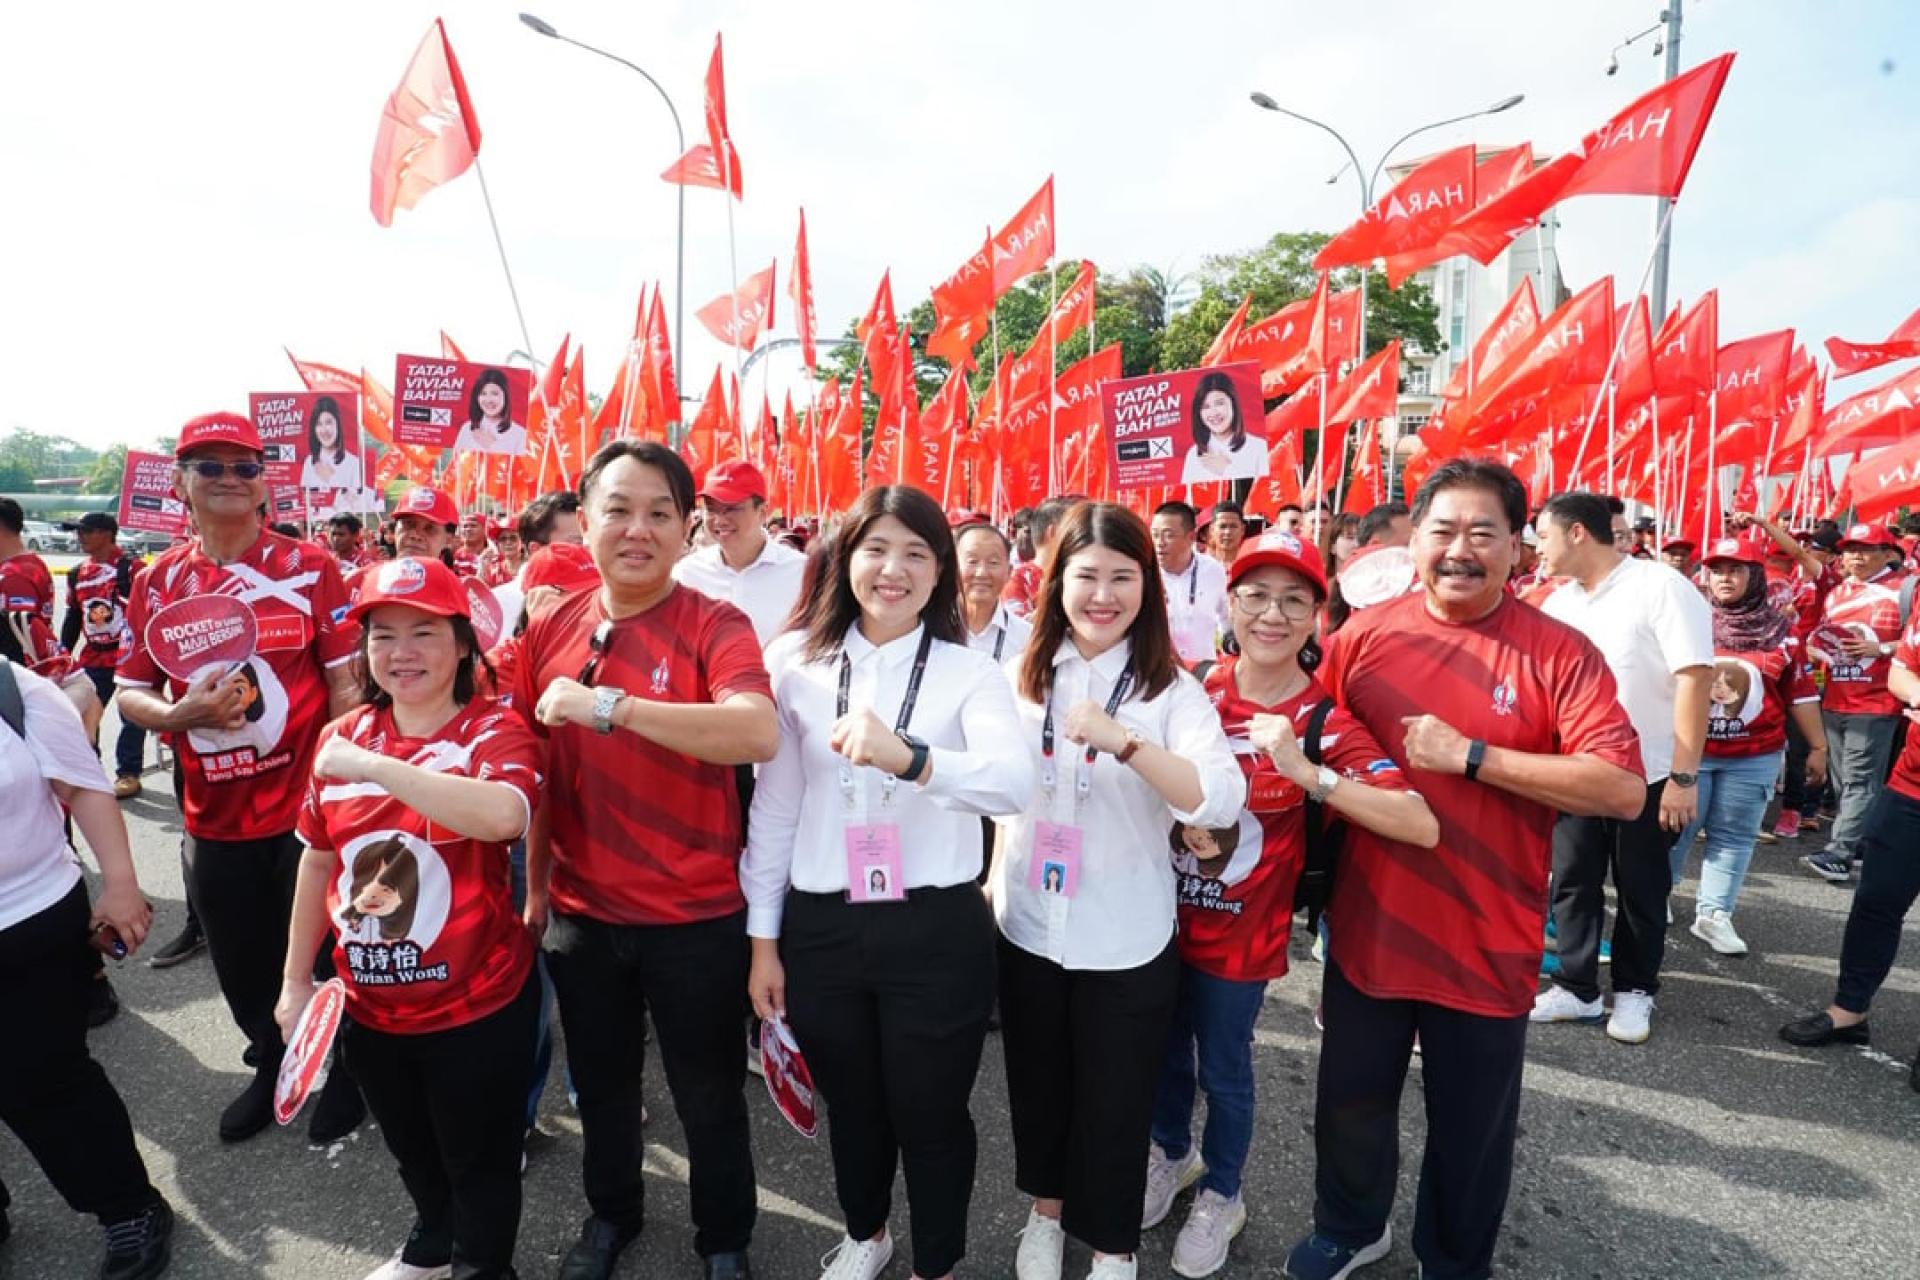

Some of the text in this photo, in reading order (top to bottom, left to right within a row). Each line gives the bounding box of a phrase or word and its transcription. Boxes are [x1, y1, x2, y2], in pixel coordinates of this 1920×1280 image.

[406, 365, 456, 376] TATAP
[406, 377, 464, 389] VIVIAN
[403, 389, 437, 401] BAH
[1115, 382, 1169, 407] TATAP
[258, 398, 295, 413] TATAP
[1115, 393, 1181, 422] VIVIAN
[257, 409, 303, 426] VIVIAN
[1115, 415, 1152, 438] BAH
[161, 618, 214, 643] ROCKET
[1203, 897, 1241, 914] Wong
[398, 964, 447, 981] Wong
